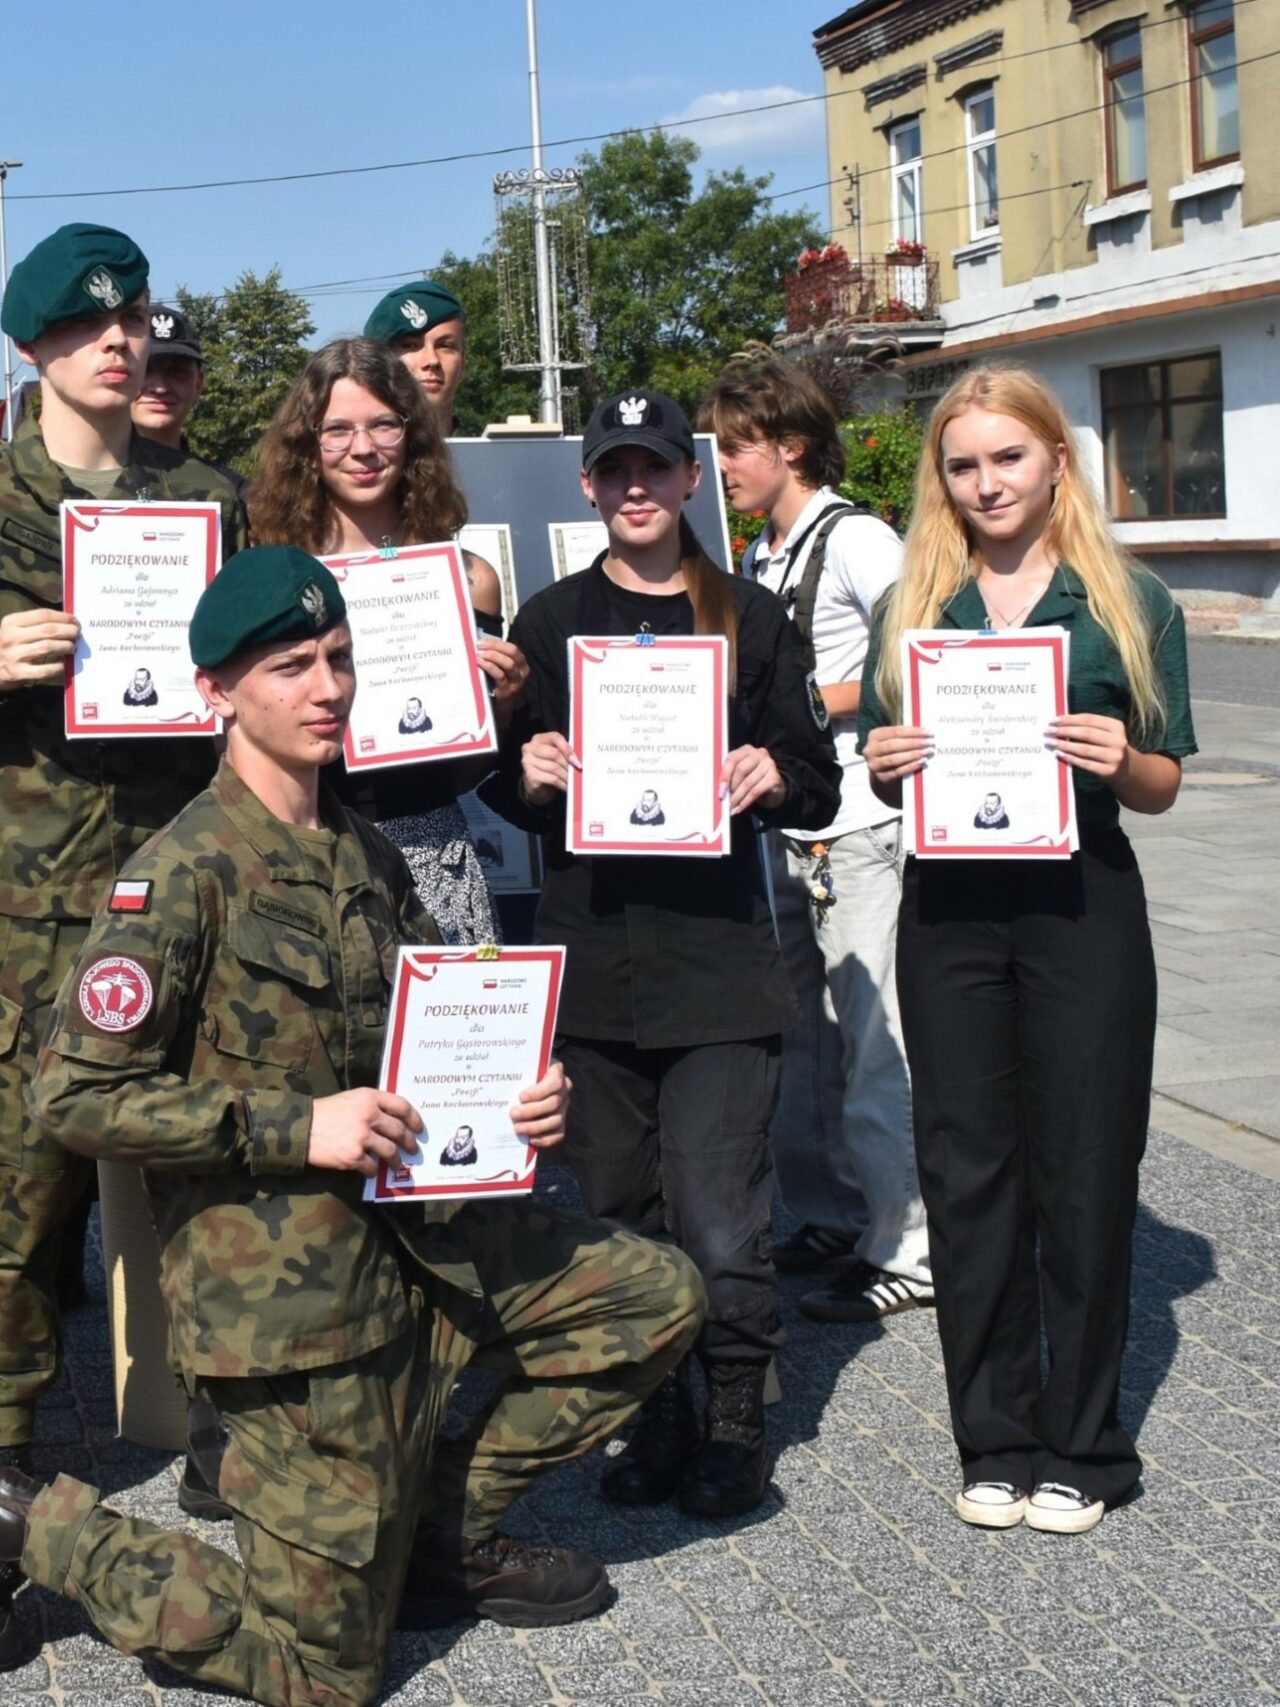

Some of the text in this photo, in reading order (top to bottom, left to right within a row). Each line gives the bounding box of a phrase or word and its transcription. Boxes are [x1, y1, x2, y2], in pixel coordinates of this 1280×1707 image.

[90, 554, 189, 569] PODZIĘKOWANIE
[347, 589, 441, 610] PODZIĘKOWANIE
[89, 619, 191, 628] NARODOWYM CZYTANIU
[355, 648, 453, 667] NARODOWYM CZYTANIU
[599, 683, 697, 697] PODZIĘKOWANIE
[936, 683, 1038, 698] PODZIĘKOWANIE
[597, 744, 699, 753] NARODOWYM CZYTANIU
[936, 745, 1042, 755] NARODOWYM CZYTANIU
[424, 1002, 530, 1020] PODZIĘKOWANIE
[469, 1022, 485, 1033] dla
[418, 1038, 454, 1050] Patryka
[413, 1072, 523, 1084] NARODOWYM CZYTANIU
[420, 1098, 509, 1110] Jana Kochanowskiego
